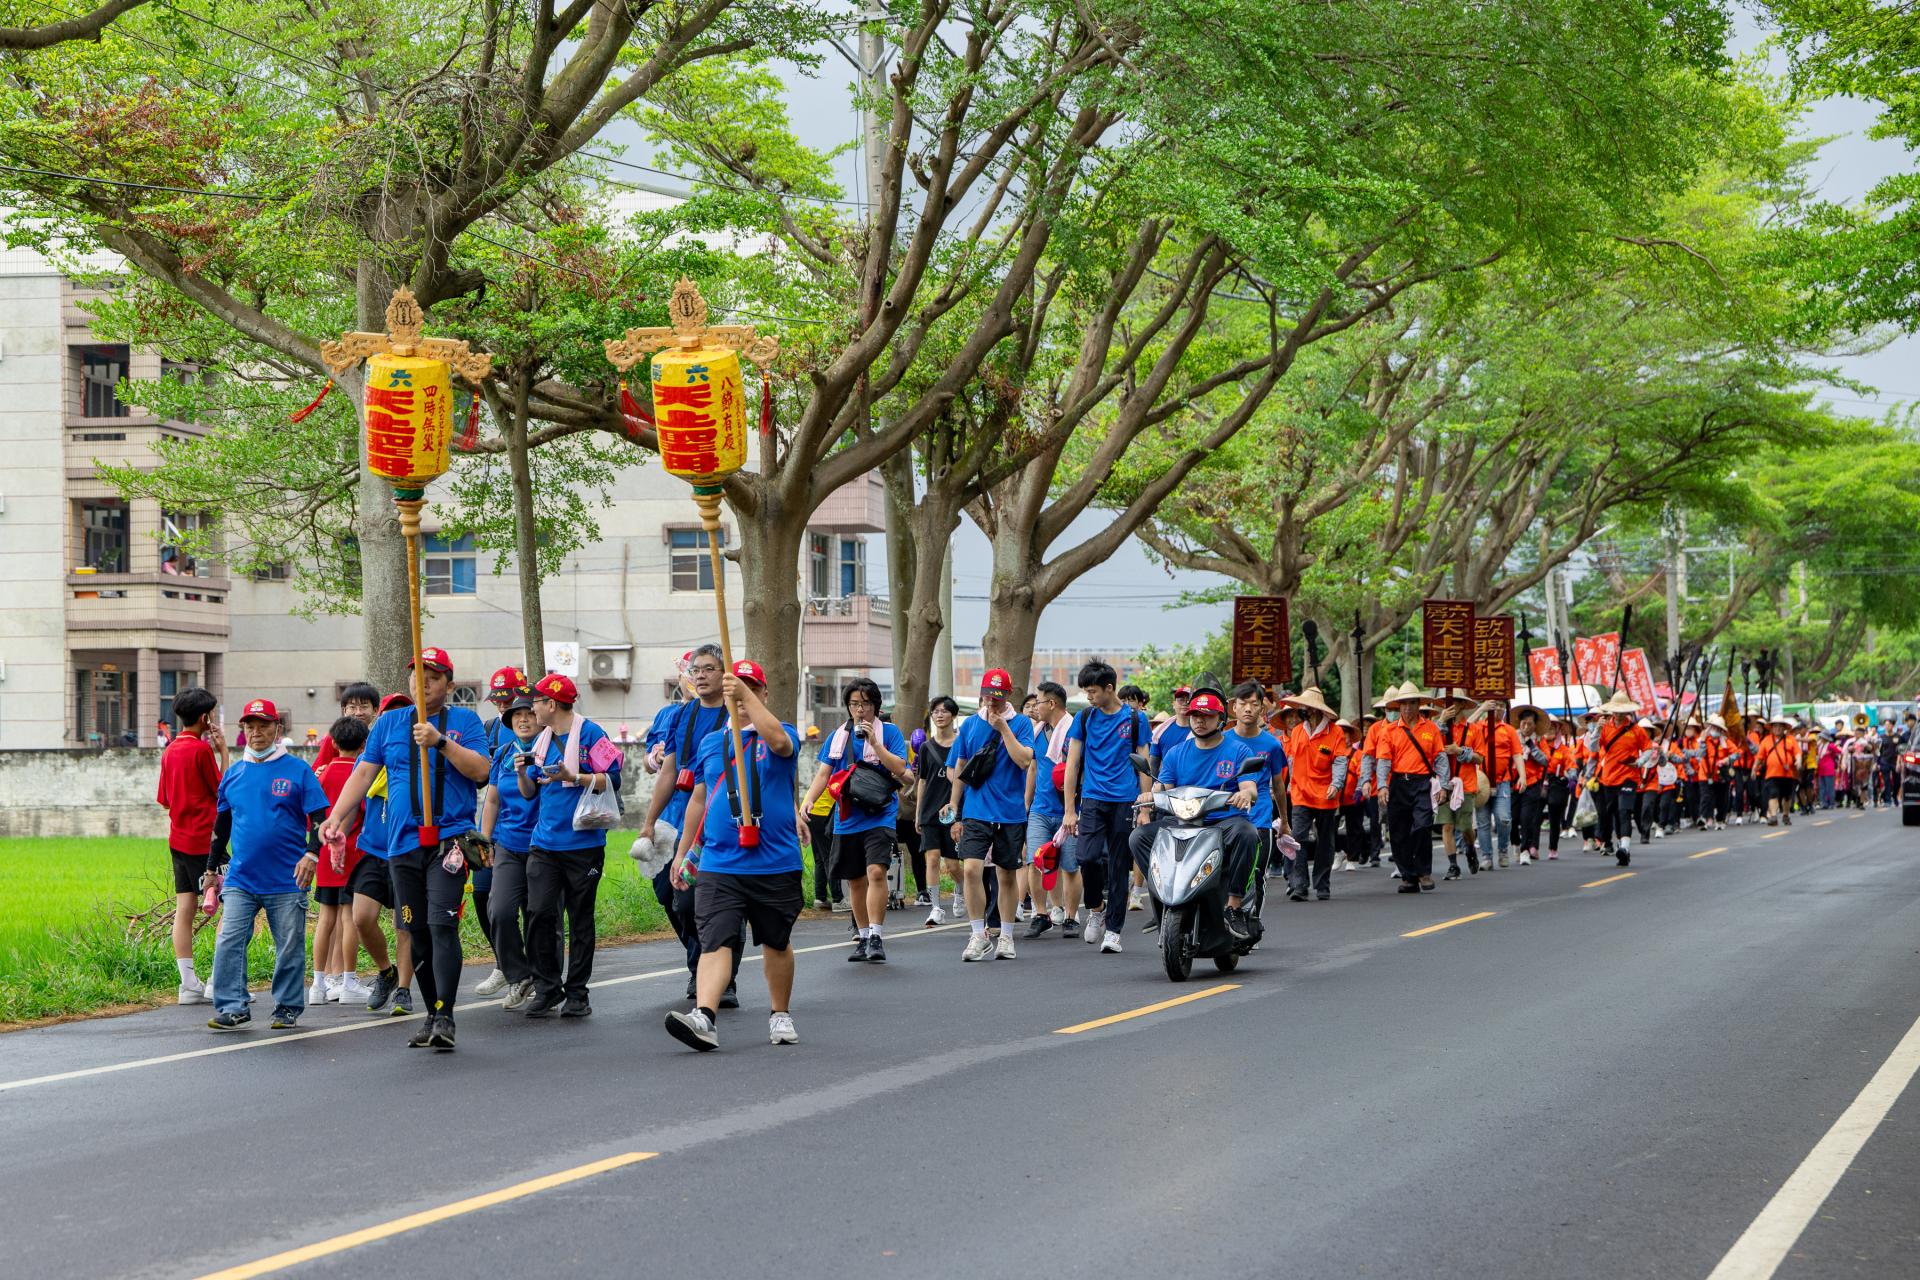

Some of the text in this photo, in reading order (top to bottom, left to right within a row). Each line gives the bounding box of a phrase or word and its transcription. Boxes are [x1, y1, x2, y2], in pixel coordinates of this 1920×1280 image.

[422, 385, 438, 452] 四時無災
[1241, 614, 1274, 680] 天上聖母
[1432, 619, 1464, 684] 天上聖母
[1473, 619, 1505, 696] 欽賜祀典
